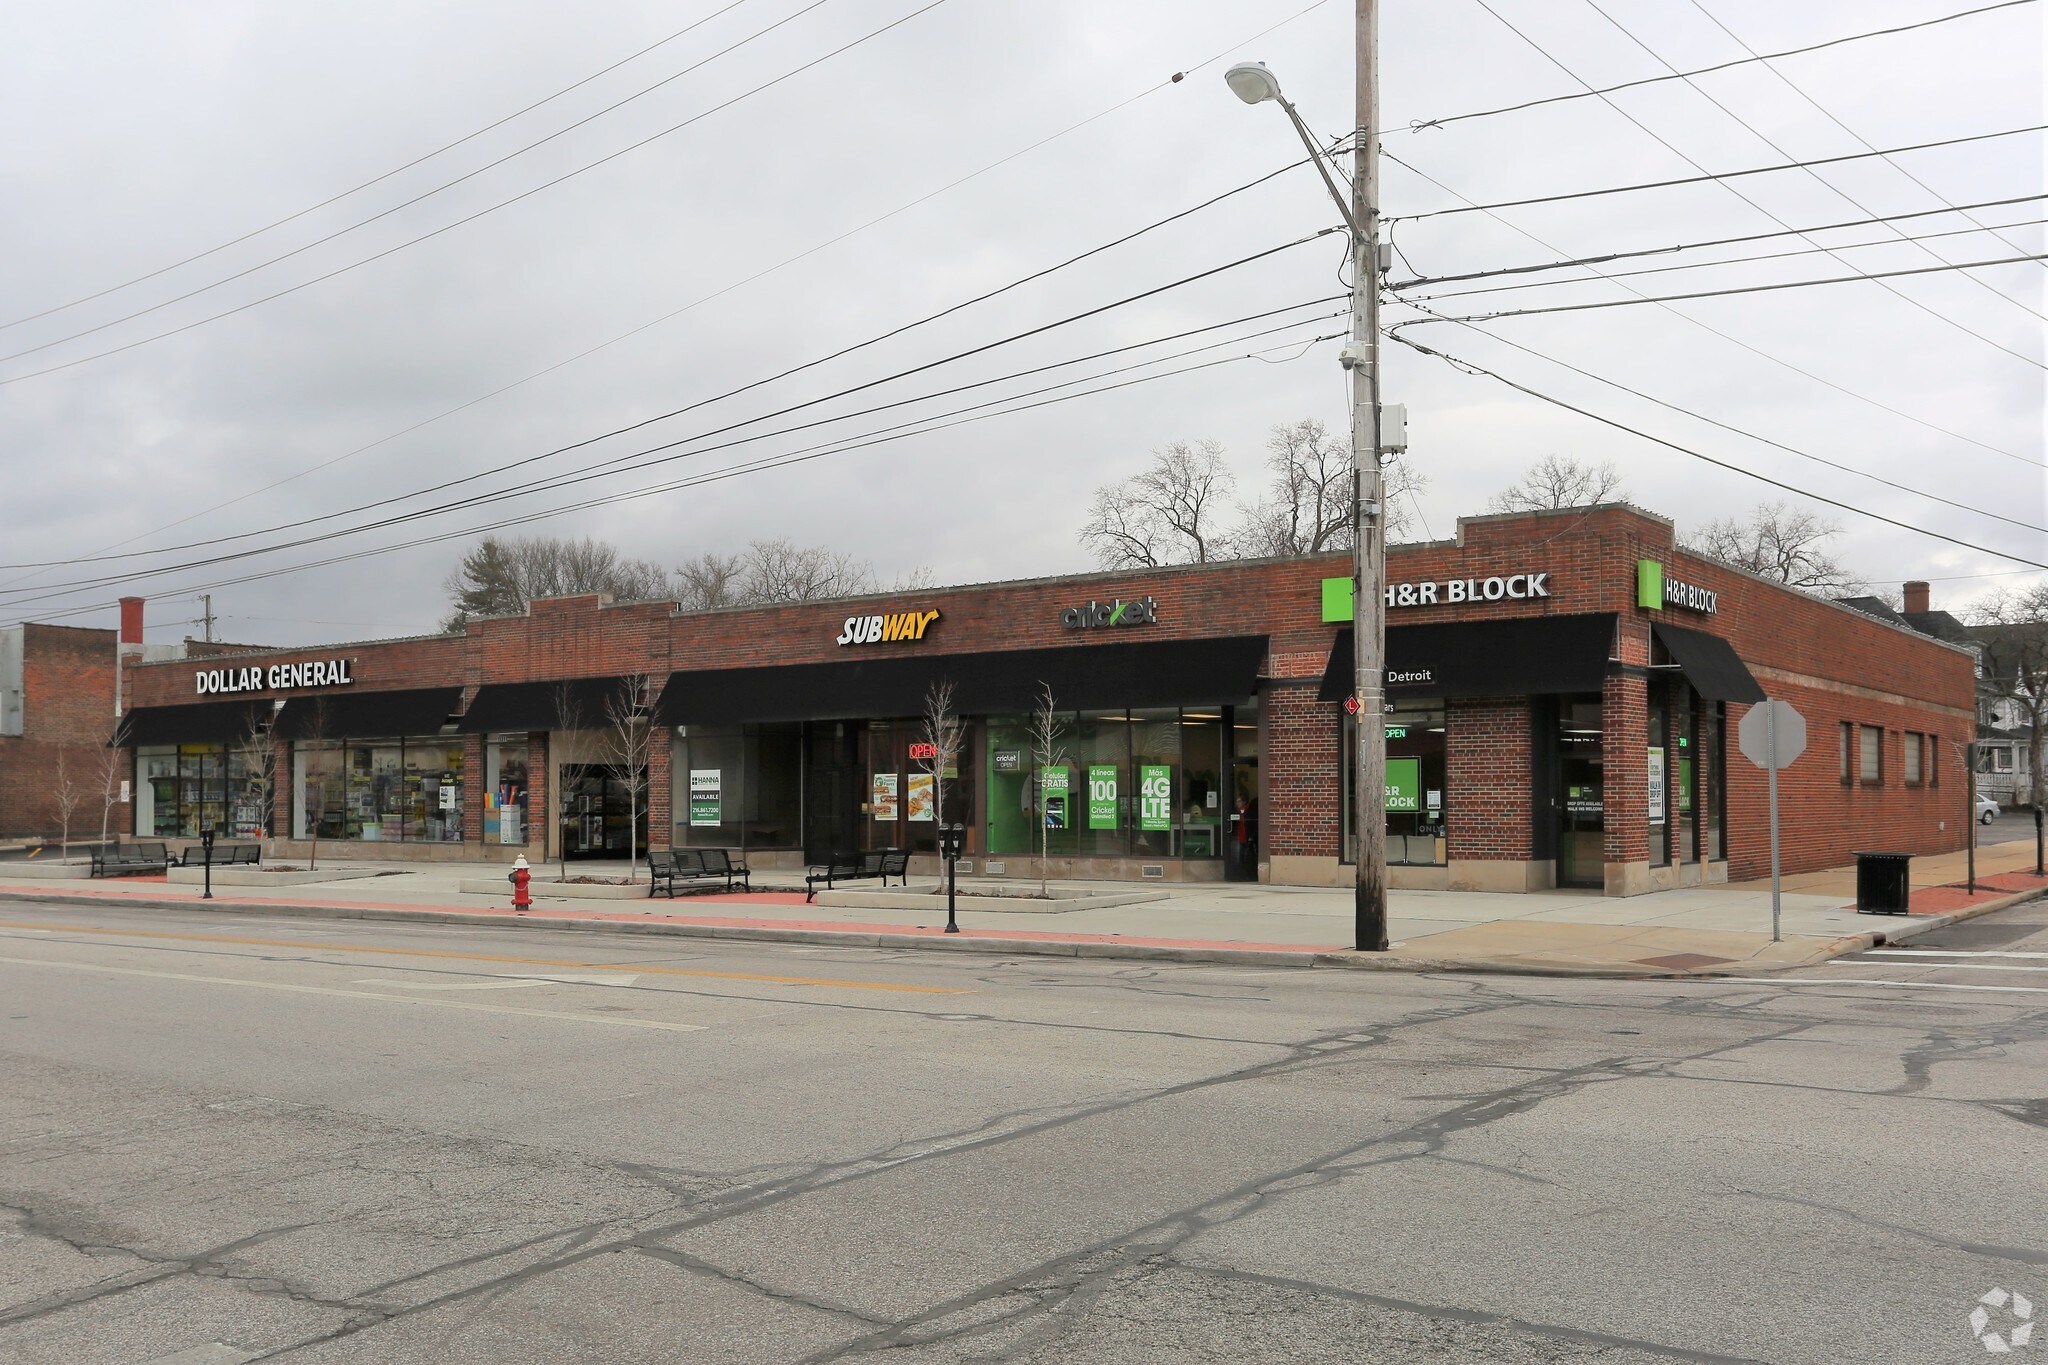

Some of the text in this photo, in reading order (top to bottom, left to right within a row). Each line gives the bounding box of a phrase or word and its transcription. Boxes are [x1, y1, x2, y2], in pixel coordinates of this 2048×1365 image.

[1449, 573, 1548, 603] BLOCK
[1666, 578, 1718, 614] H&R BLOCK
[1060, 596, 1157, 629] cricket
[836, 608, 940, 646] SUBWAY
[196, 659, 351, 694] DOLLAR GENERAL
[1388, 669, 1432, 682] Detroit
[1349, 701, 1355, 710] L
[909, 743, 938, 758] OPEN
[996, 754, 1017, 762] cricket
[1148, 768, 1163, 777] Más
[1141, 777, 1171, 798] 4G
[1385, 786, 1400, 796] &R
[1091, 806, 1115, 814] Cricket
[1141, 797, 1171, 819] LTE
